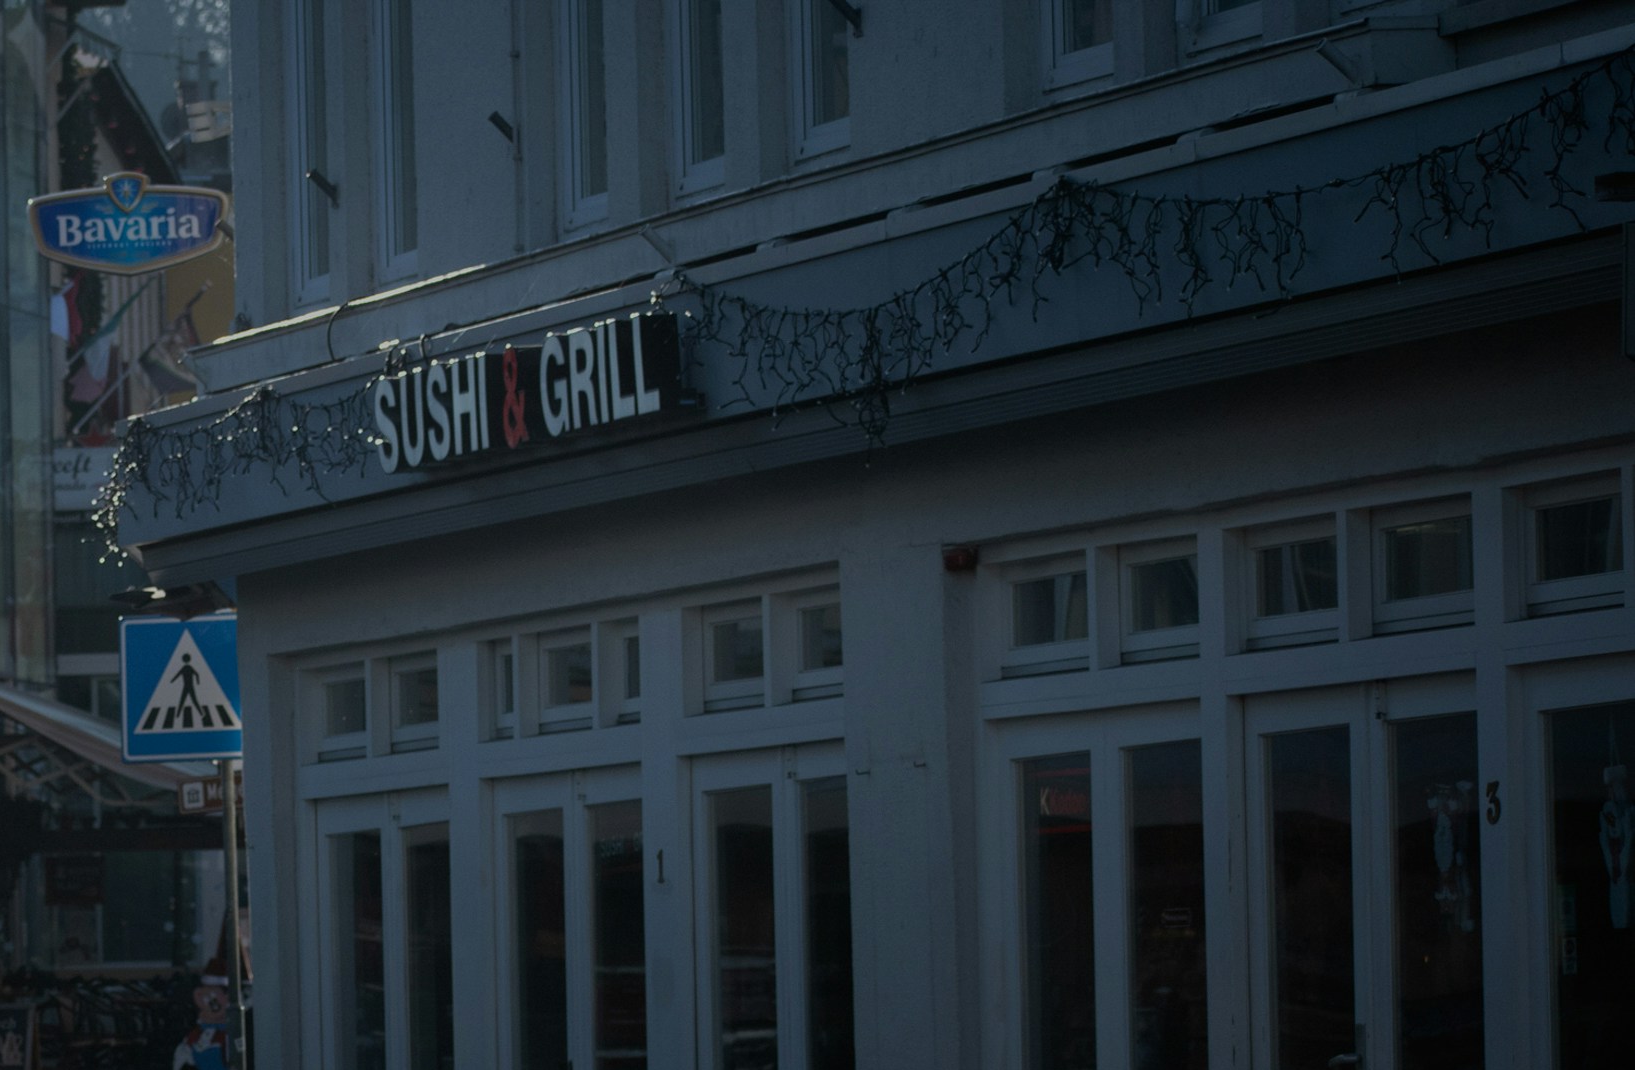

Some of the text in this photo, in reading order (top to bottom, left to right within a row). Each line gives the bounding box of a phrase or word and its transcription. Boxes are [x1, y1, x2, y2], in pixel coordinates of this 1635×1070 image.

[56, 207, 202, 247] Bavaria
[374, 312, 661, 474] SUSHI & GRILL
[1485, 780, 1502, 826] 3
[656, 848, 666, 884] 1
